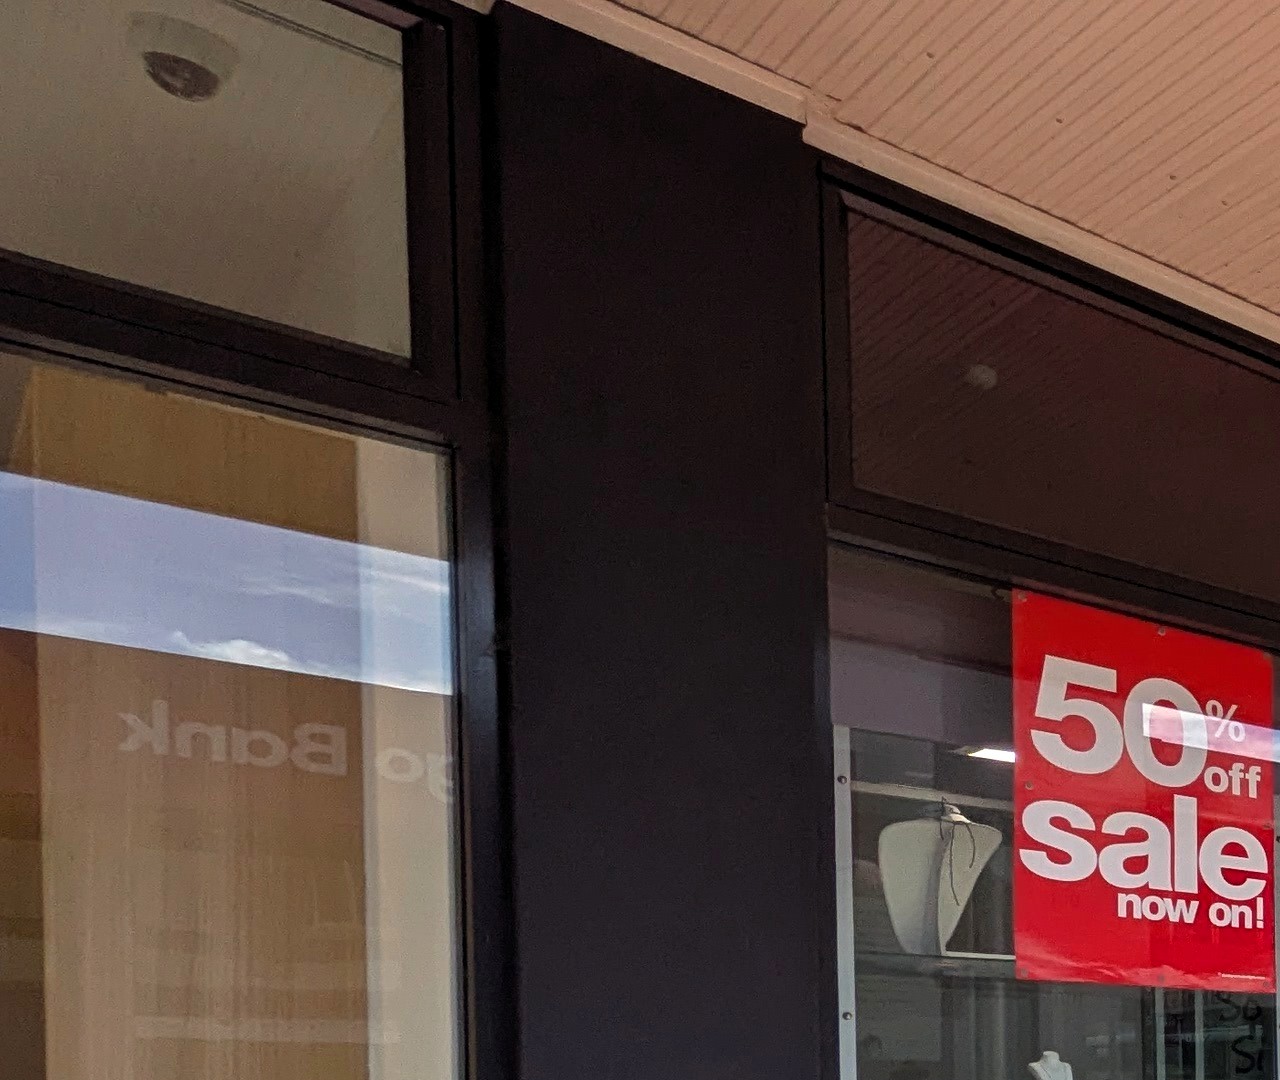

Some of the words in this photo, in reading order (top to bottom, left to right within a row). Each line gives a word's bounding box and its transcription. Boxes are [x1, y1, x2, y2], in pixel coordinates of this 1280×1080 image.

[1030, 654, 1246, 788] 50%
[1204, 762, 1262, 799] off
[1018, 793, 1269, 902] sale
[1117, 892, 1199, 924] now
[1208, 896, 1265, 929] on!
